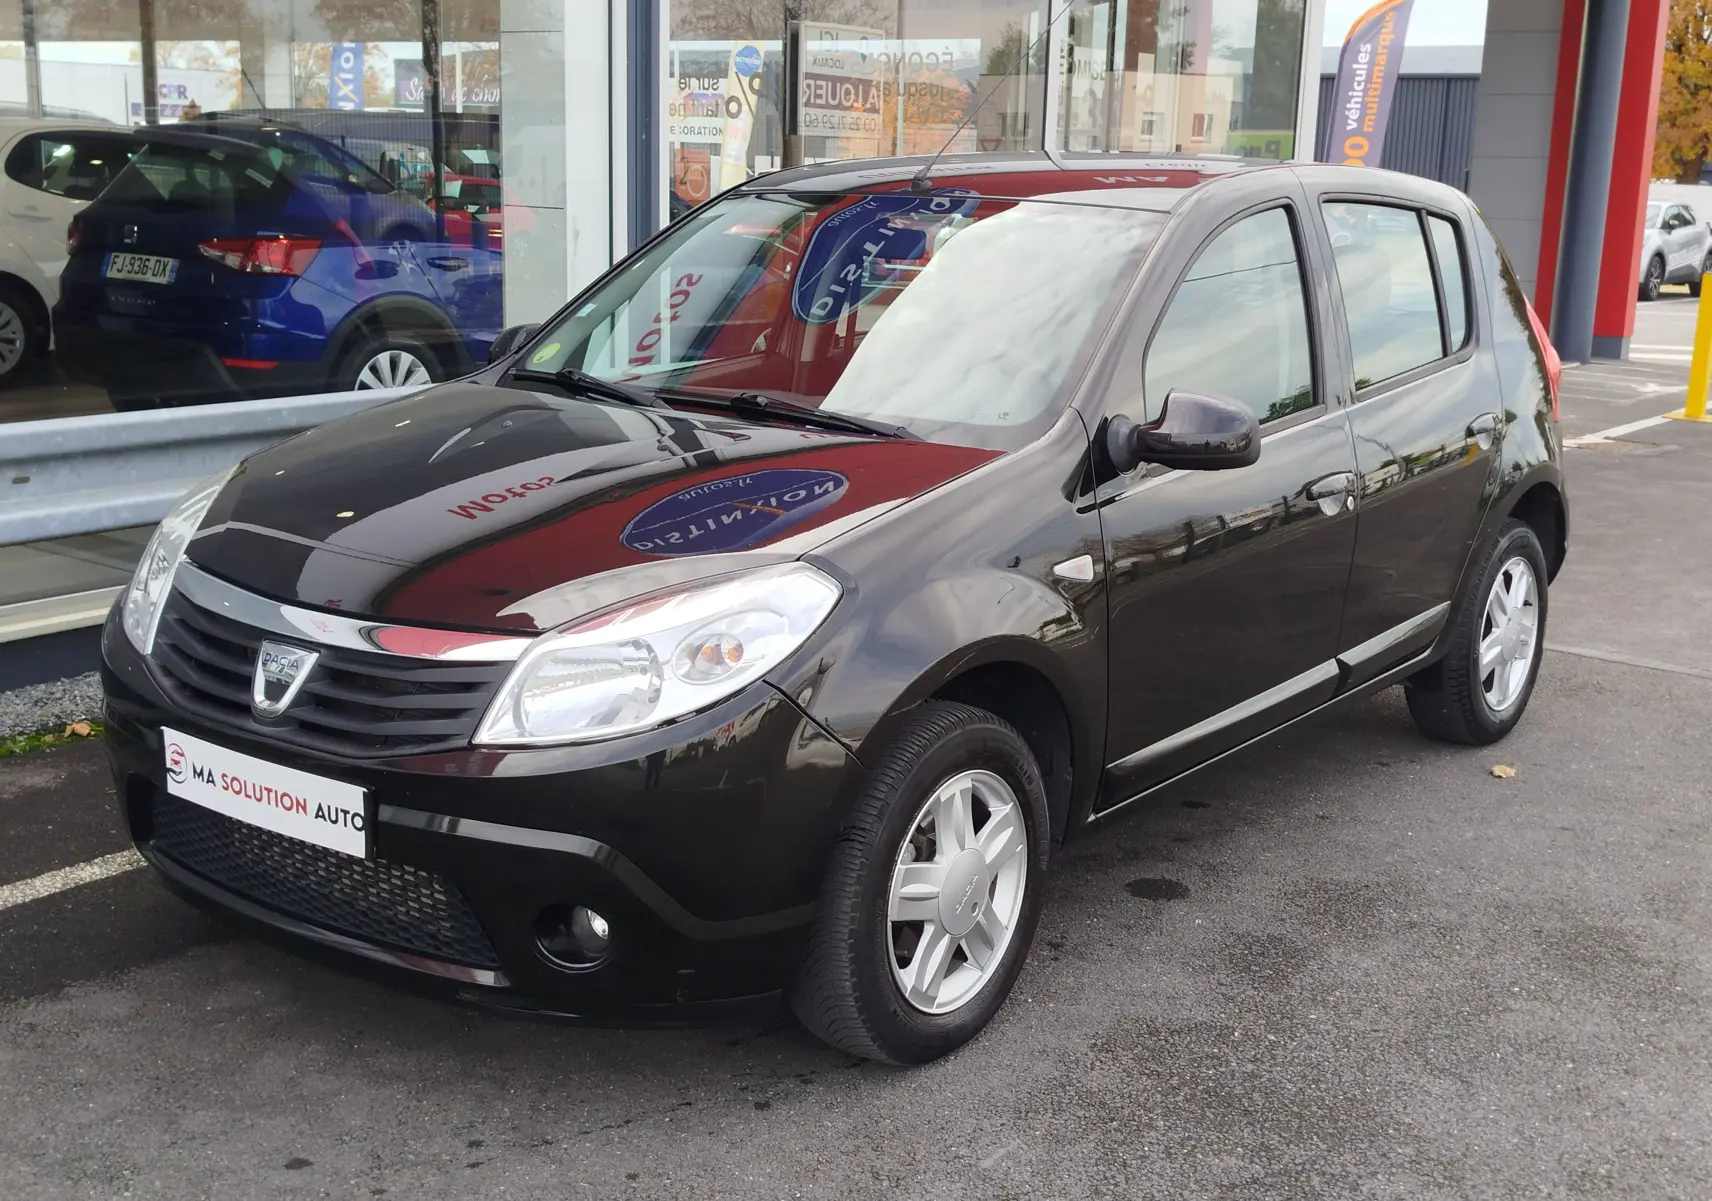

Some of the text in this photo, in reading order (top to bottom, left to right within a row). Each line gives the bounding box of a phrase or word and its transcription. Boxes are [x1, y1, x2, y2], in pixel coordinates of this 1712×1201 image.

[1345, 43, 1372, 131] véhicules
[264, 652, 299, 670] DACIA
[192, 761, 365, 832] MA SOLUTION AUTO
